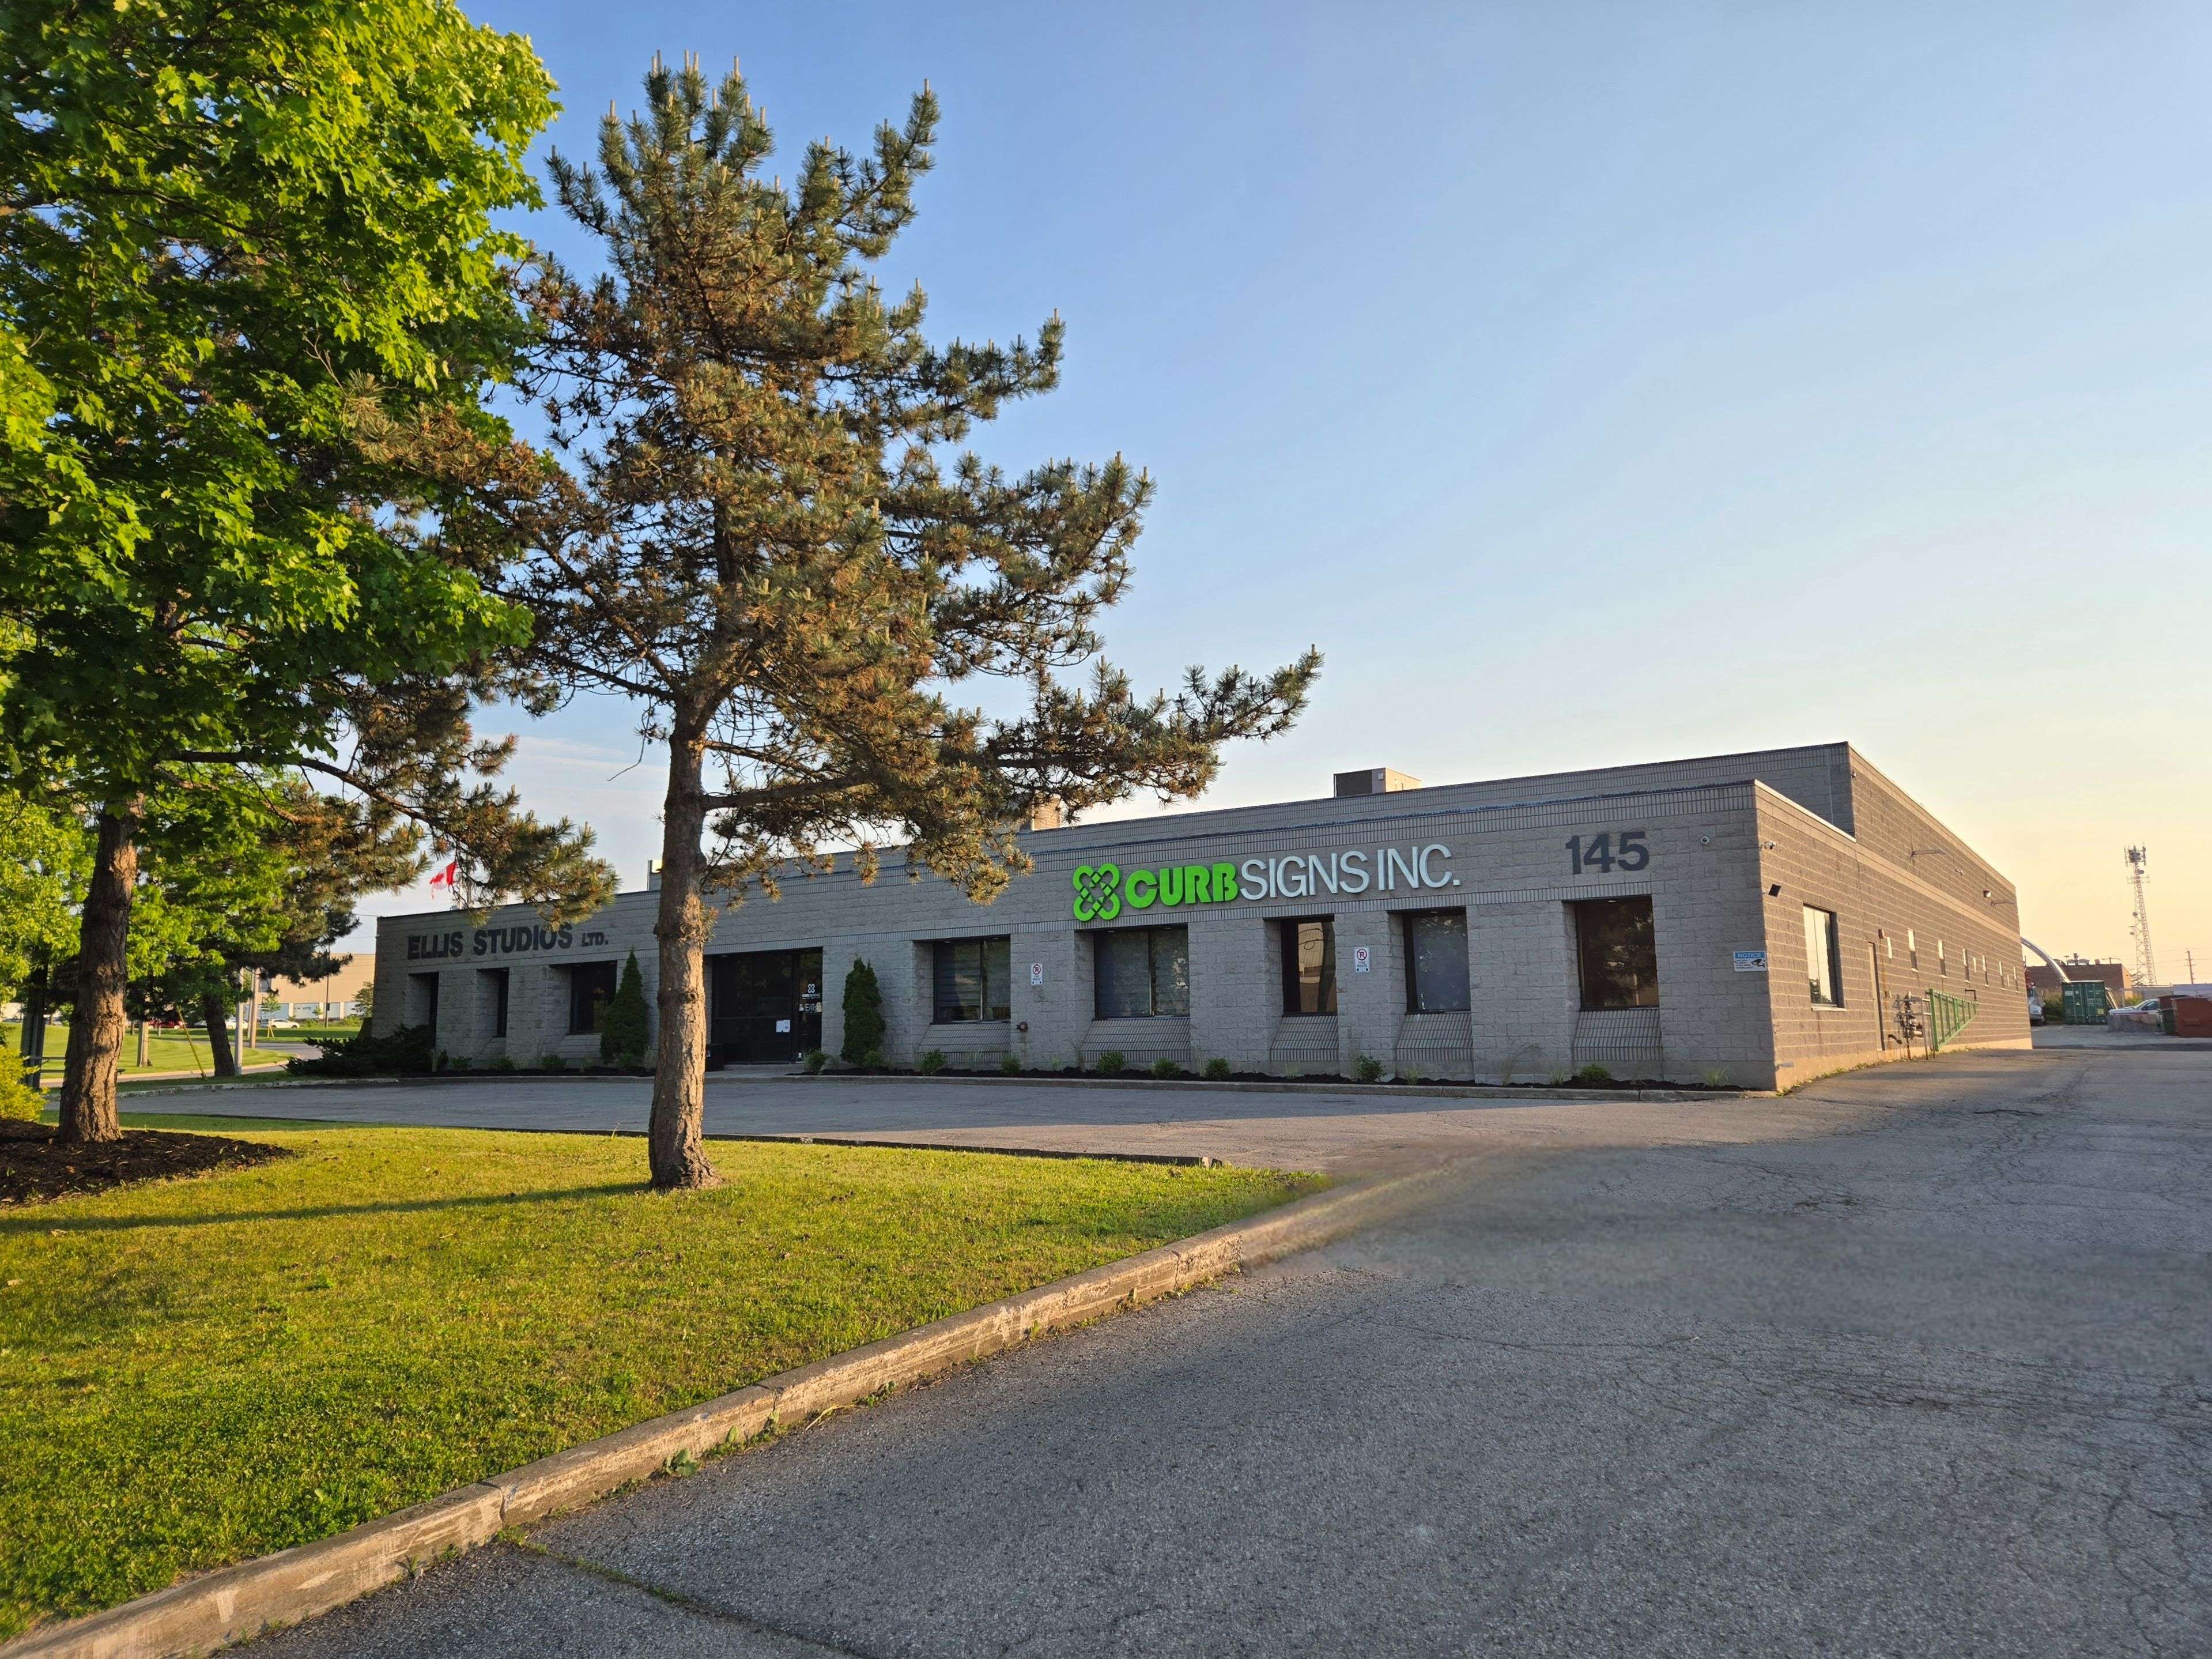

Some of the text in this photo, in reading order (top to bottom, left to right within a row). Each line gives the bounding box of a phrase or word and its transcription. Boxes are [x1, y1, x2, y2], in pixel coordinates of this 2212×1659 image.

[1377, 844, 1461, 891] INC.
[1566, 831, 1649, 875] 145
[407, 922, 609, 960] ELLIS STUDIOS LTD.
